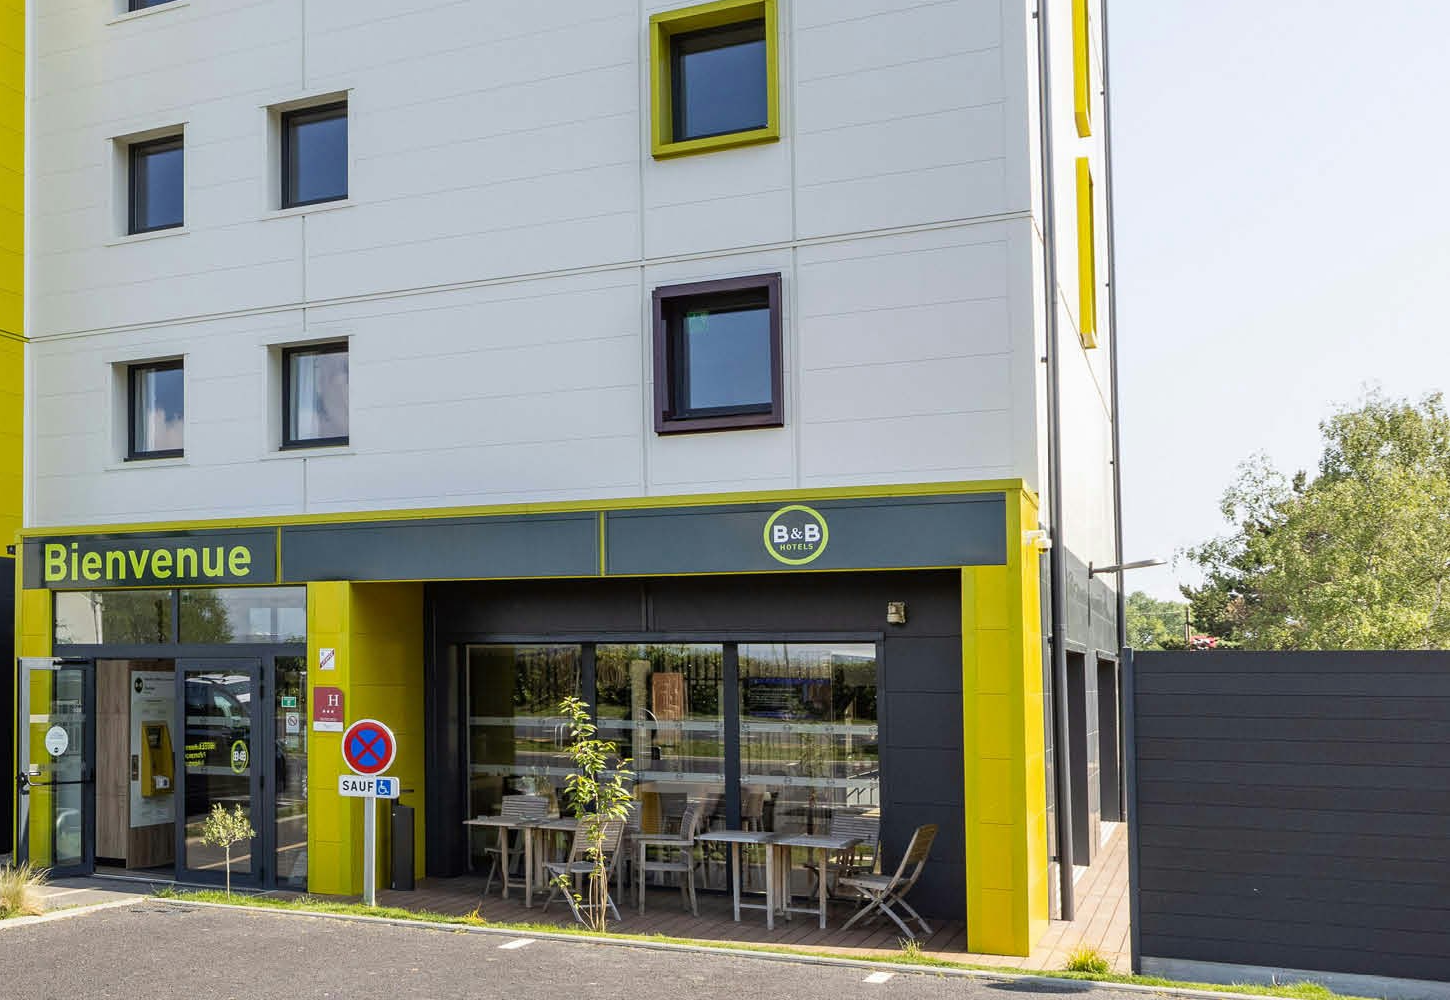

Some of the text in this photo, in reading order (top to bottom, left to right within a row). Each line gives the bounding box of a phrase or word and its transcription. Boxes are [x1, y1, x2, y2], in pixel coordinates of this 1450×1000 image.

[773, 523, 821, 543] B&B
[780, 543, 814, 551] HOTELS
[44, 542, 252, 582] Bienvenue
[327, 694, 340, 707] H
[342, 780, 374, 792] SAUF
